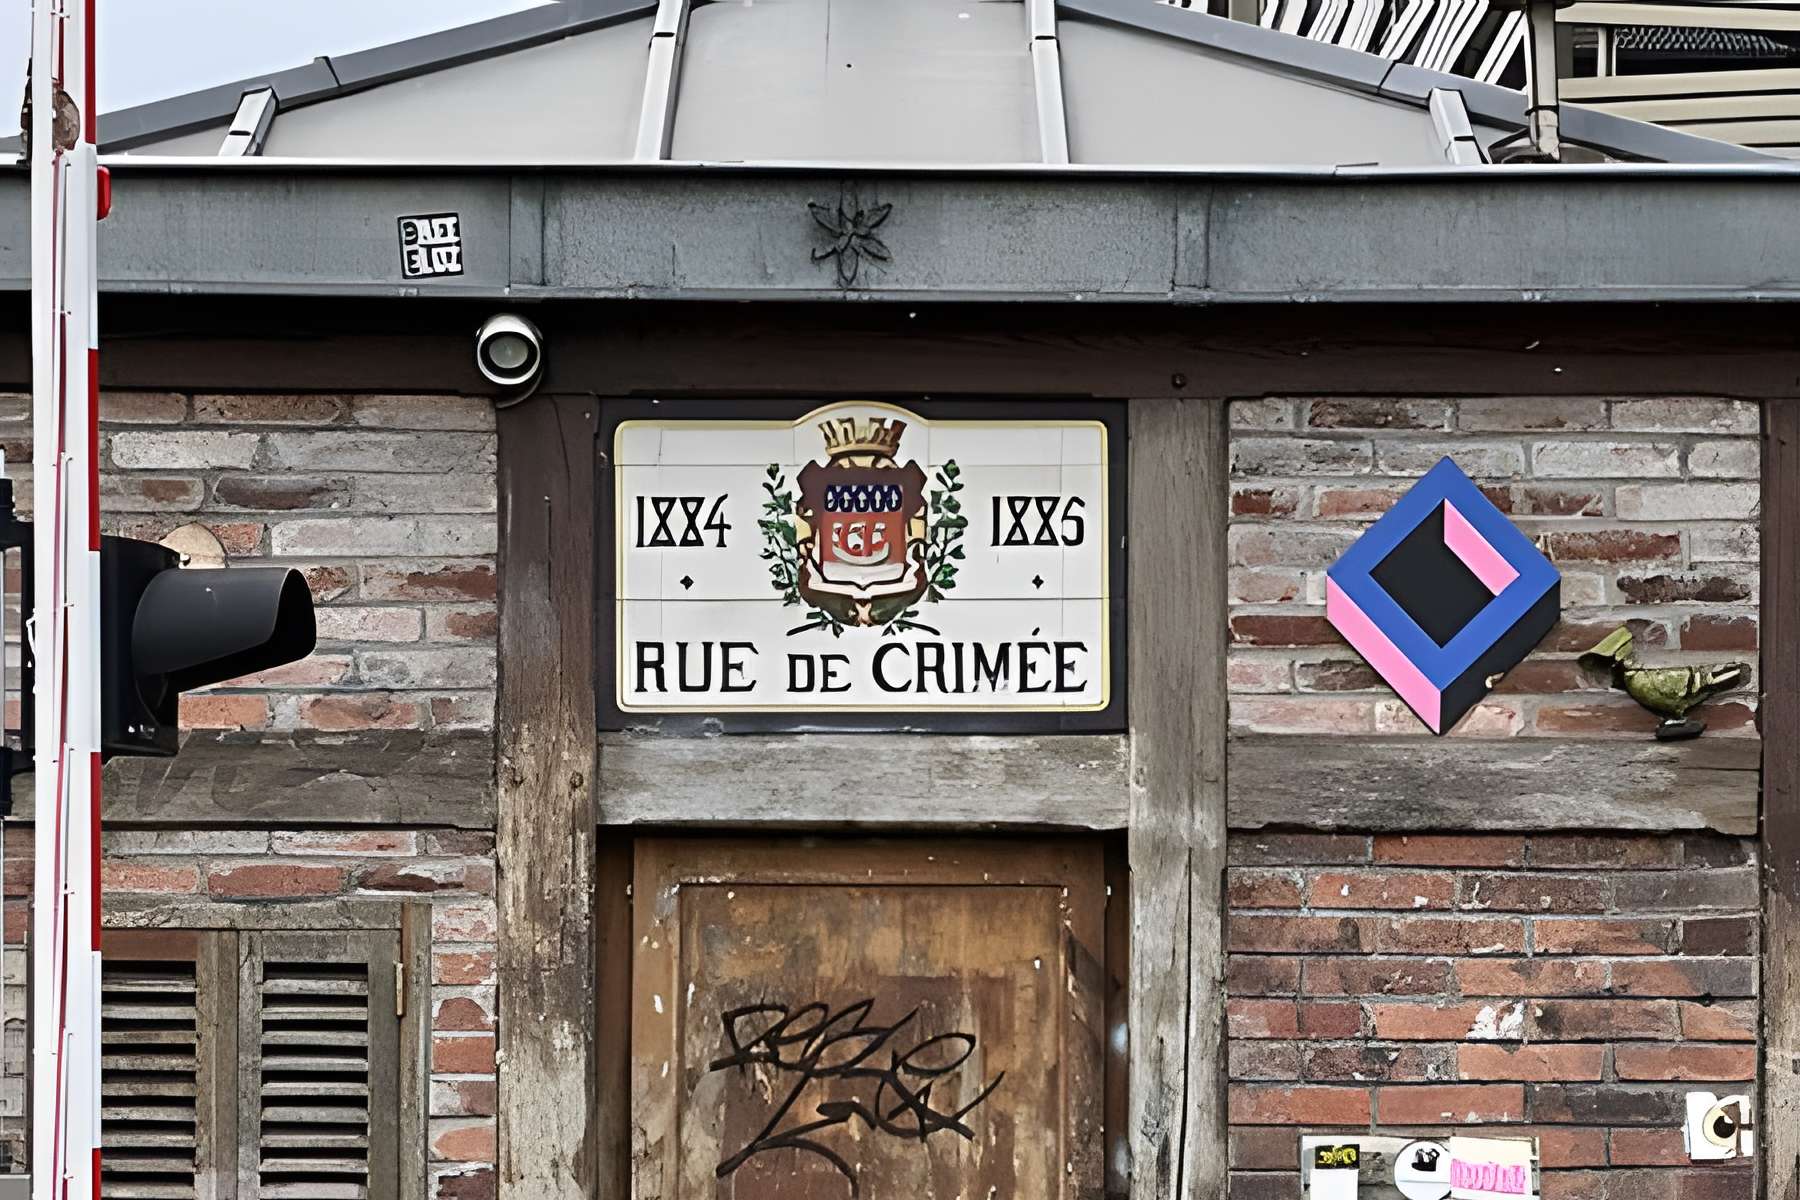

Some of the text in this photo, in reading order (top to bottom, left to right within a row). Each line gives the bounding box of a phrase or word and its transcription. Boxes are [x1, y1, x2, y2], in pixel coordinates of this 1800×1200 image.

[635, 493, 732, 548] 1884
[634, 627, 1088, 694] RUE DE CRIMÉE
